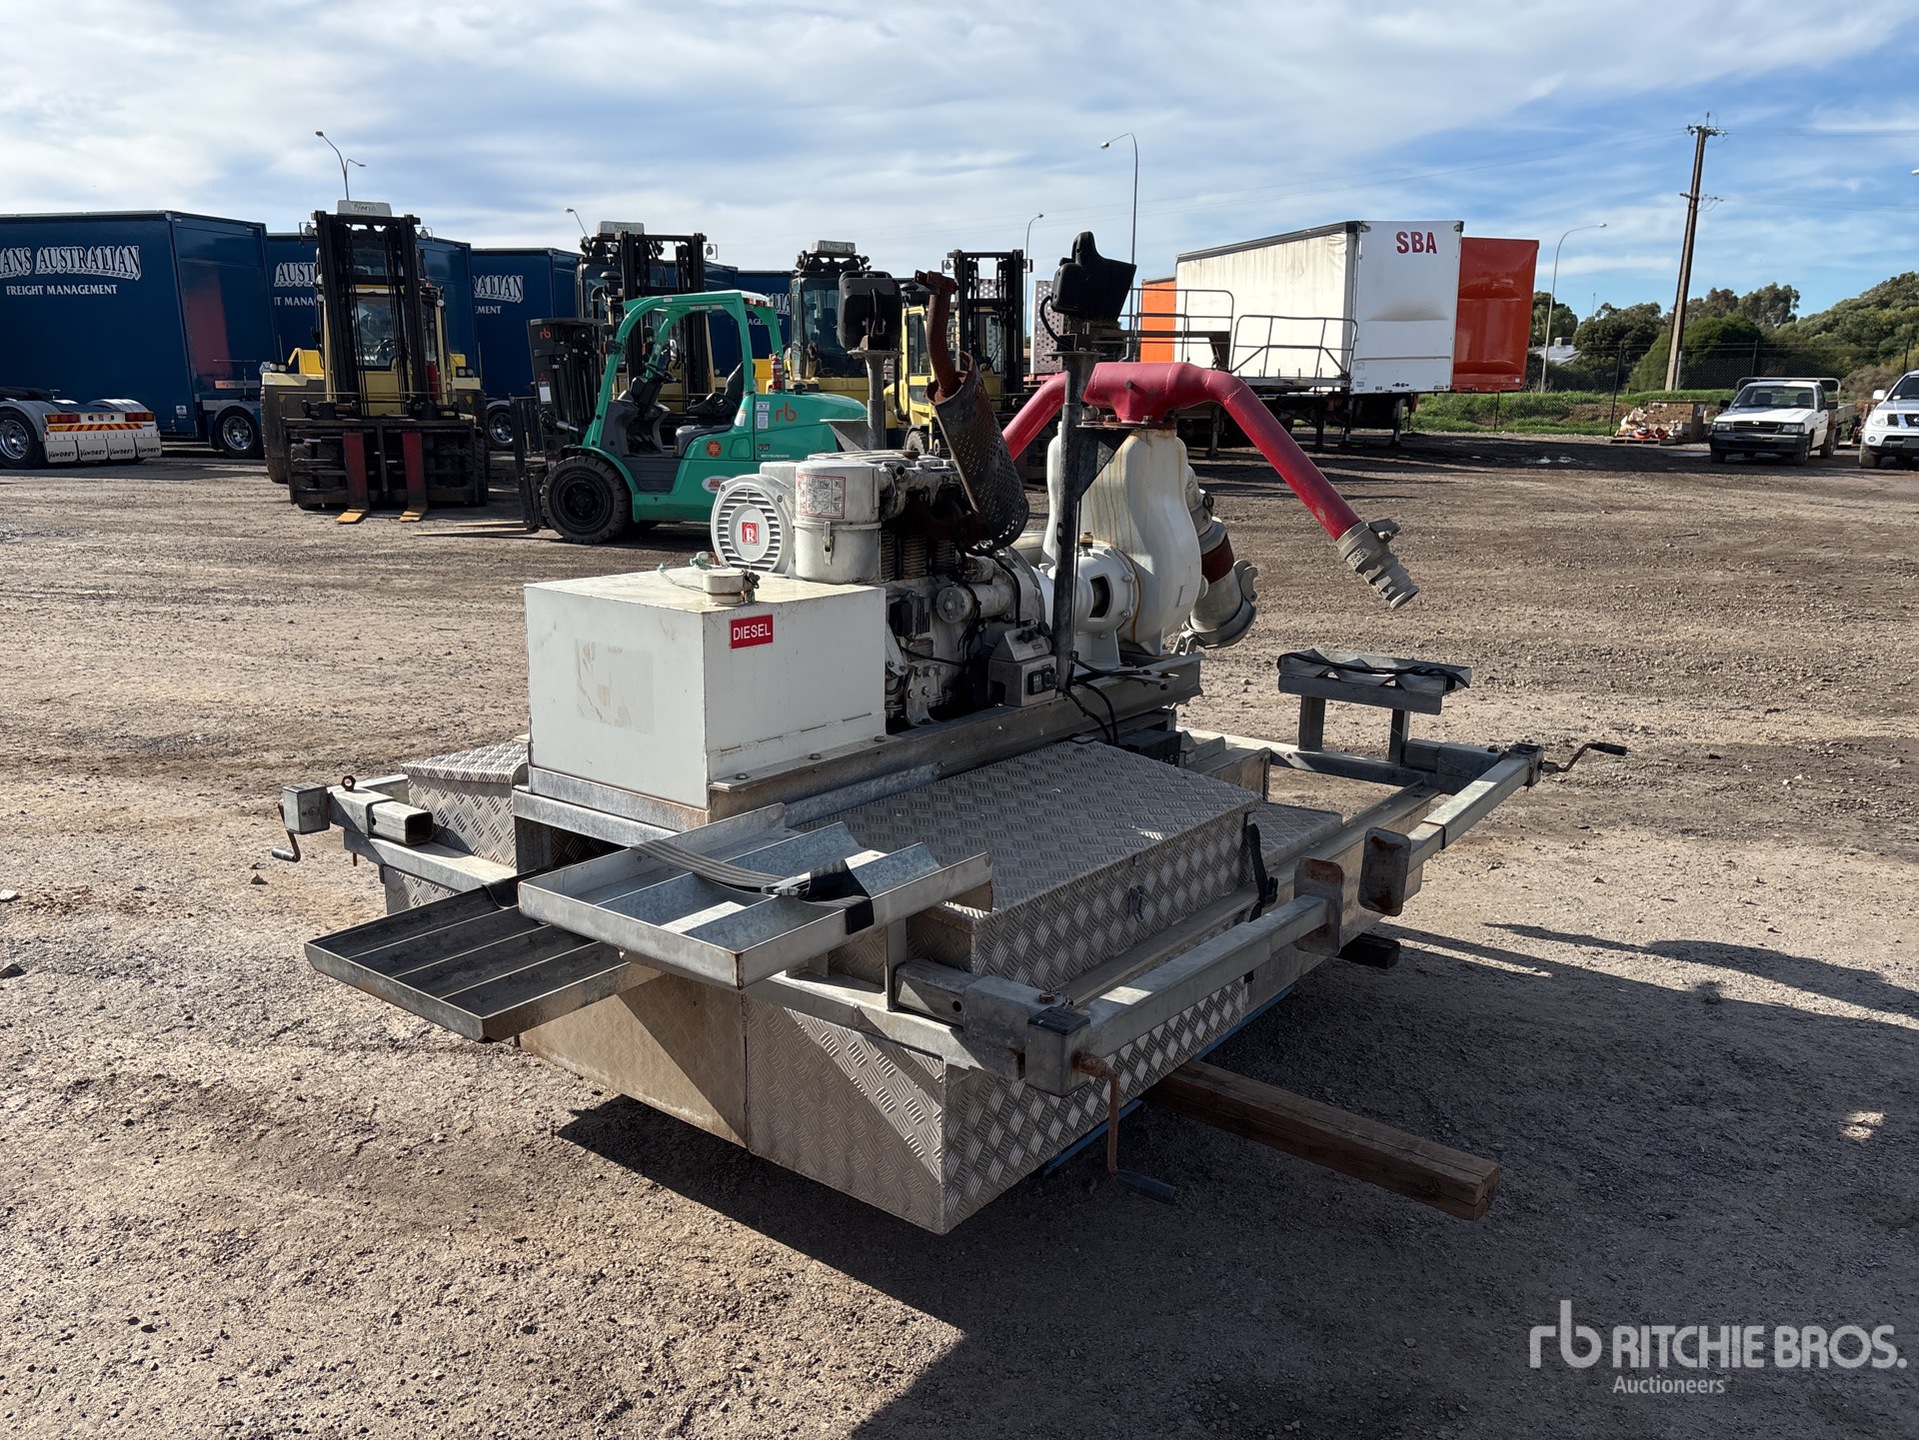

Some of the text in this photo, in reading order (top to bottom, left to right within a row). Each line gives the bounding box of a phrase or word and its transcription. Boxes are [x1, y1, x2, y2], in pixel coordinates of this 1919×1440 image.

[1395, 231, 1438, 255] SBA
[0, 245, 141, 281] ANS AUSTRALIAN
[6, 284, 118, 296] FREIGHT MANAGEMENT
[775, 401, 798, 423] rb
[733, 623, 772, 641] DIESEL
